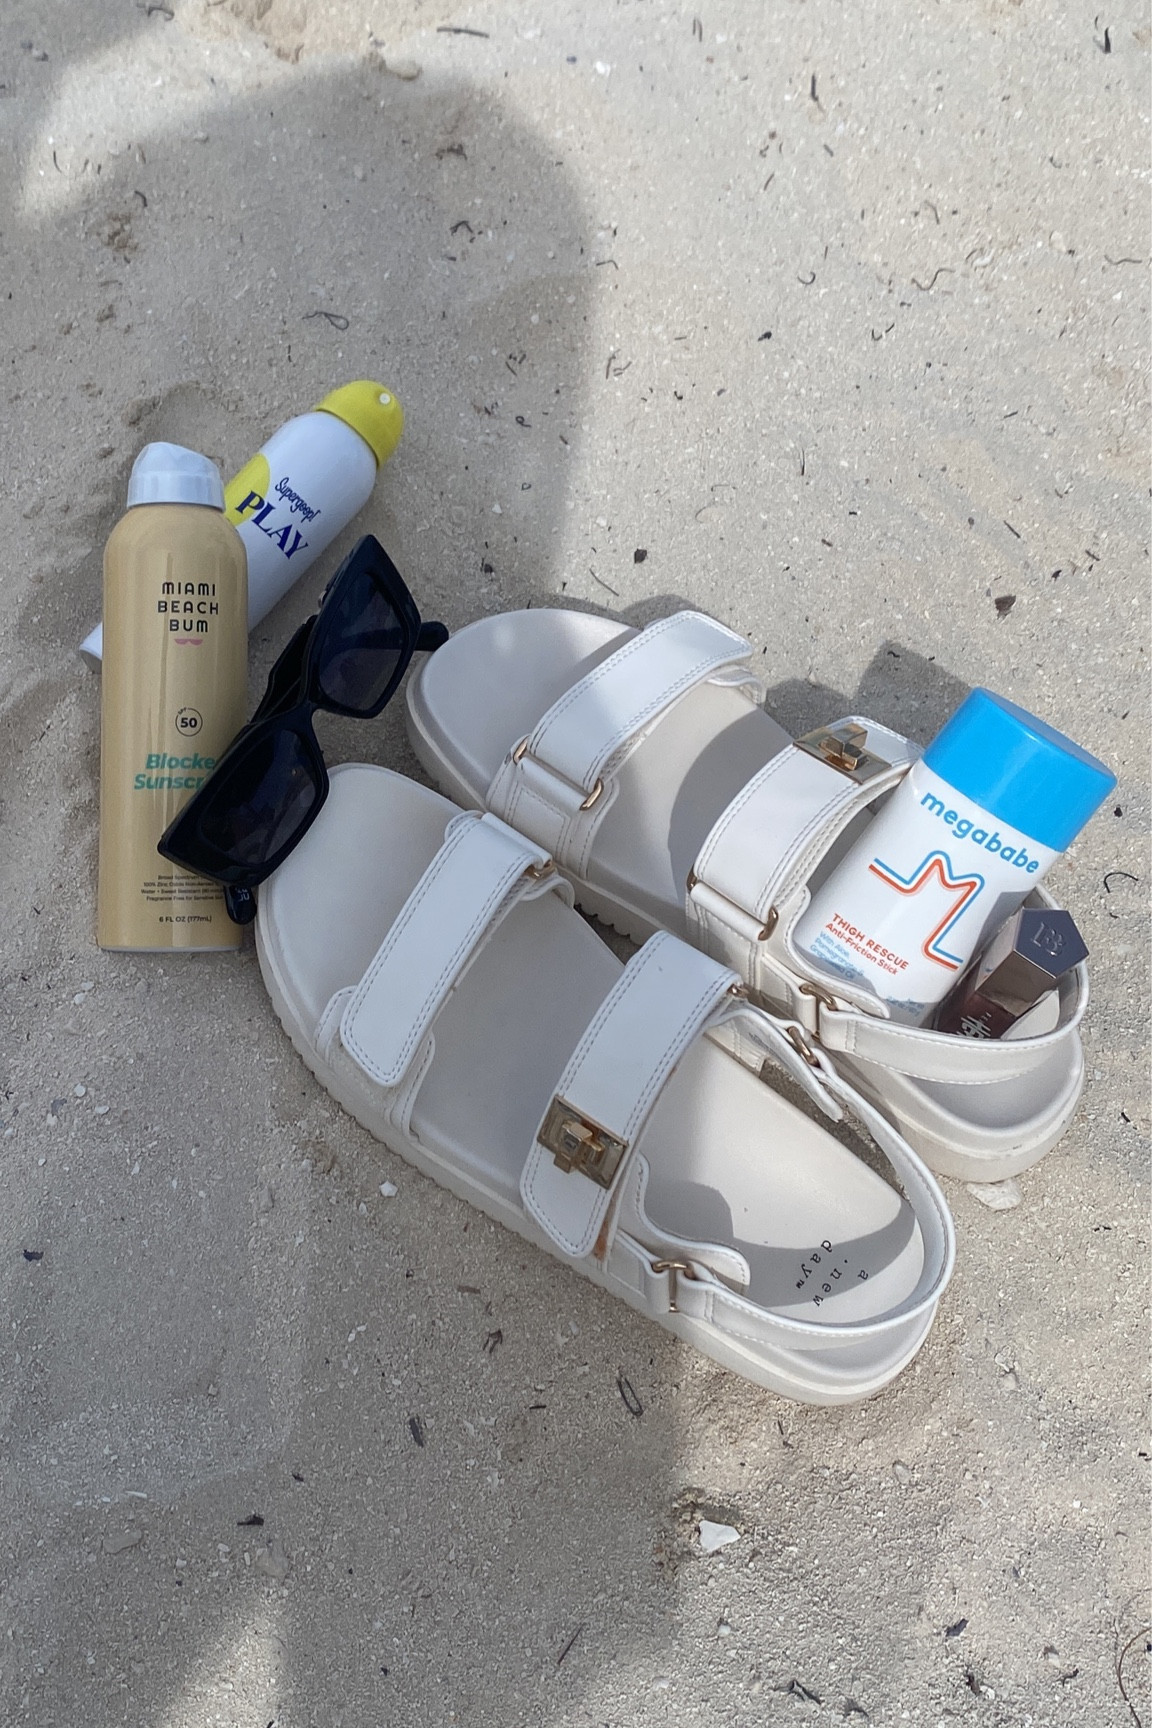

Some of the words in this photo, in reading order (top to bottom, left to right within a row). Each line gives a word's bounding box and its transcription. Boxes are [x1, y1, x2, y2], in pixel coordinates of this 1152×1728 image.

[274, 476, 321, 523] Supergoop!
[235, 490, 309, 560] PLAY
[162, 581, 216, 596] MIAMI
[158, 600, 219, 615] BEACH
[169, 619, 208, 633] BUM
[180, 717, 198, 728] 50
[920, 792, 1039, 873] megababe
[825, 923, 878, 963] Anti-Friction
[877, 959, 898, 975] Stick
[832, 913, 865, 942] THIGH
[866, 939, 909, 970] RESCUE
[858, 1270, 868, 1280] a
